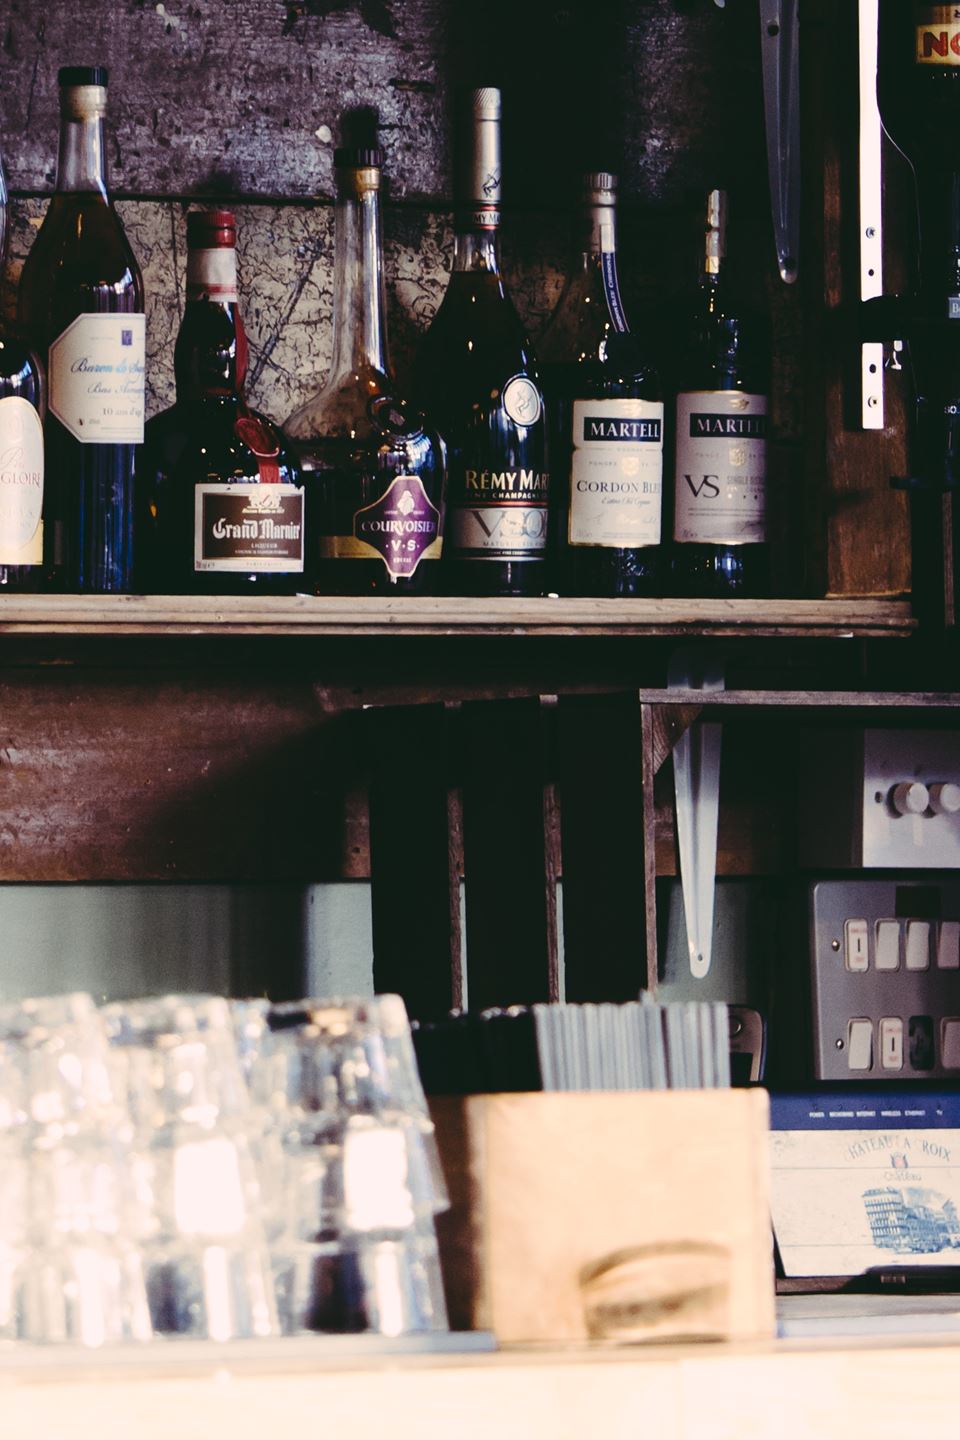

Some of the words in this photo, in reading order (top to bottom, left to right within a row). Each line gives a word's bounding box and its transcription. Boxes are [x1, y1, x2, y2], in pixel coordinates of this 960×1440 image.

[590, 422, 660, 438] MARTELL
[465, 468, 517, 491] RÉMY
[576, 479, 639, 494] CORDON
[684, 474, 721, 499] VS
[212, 518, 258, 540] Grand
[258, 518, 300, 540] Marnier
[849, 1135, 893, 1160] HATEAU
